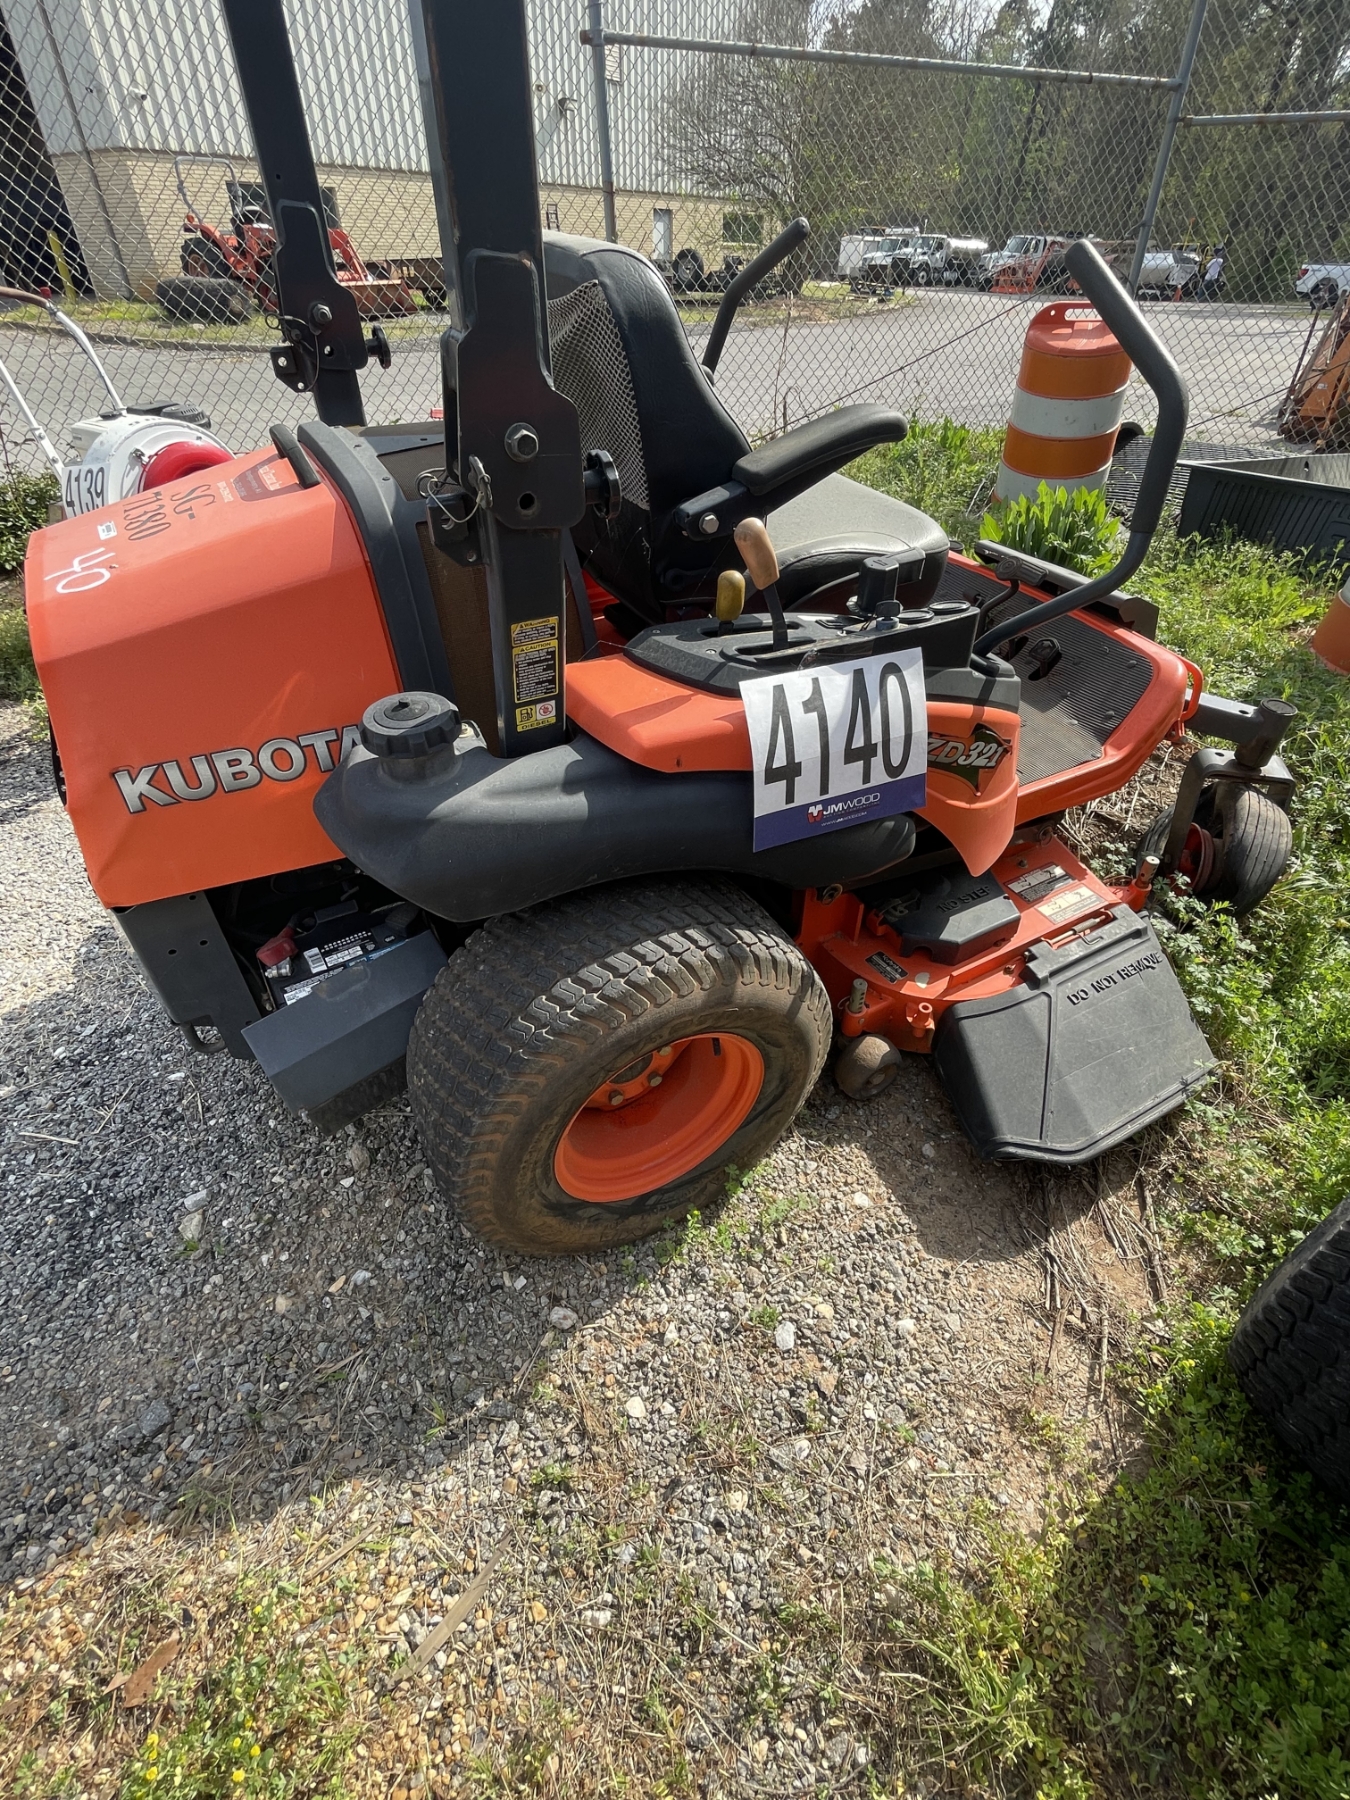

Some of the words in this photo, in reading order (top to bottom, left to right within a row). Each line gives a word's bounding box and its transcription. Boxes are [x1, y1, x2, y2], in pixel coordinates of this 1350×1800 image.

[66, 467, 105, 517] 4139
[170, 484, 217, 520] SG-
[43, 547, 116, 594] 40
[525, 642, 551, 651] CAUTION
[522, 719, 550, 730] DIESEL
[764, 662, 913, 806] 4140
[927, 737, 1007, 768] ZD321
[937, 900, 960, 913] NO
[959, 886, 991, 904] STEP
[1067, 988, 1090, 1006] DO
[1091, 973, 1118, 993] NOT
[1117, 952, 1163, 981] REMOVE
